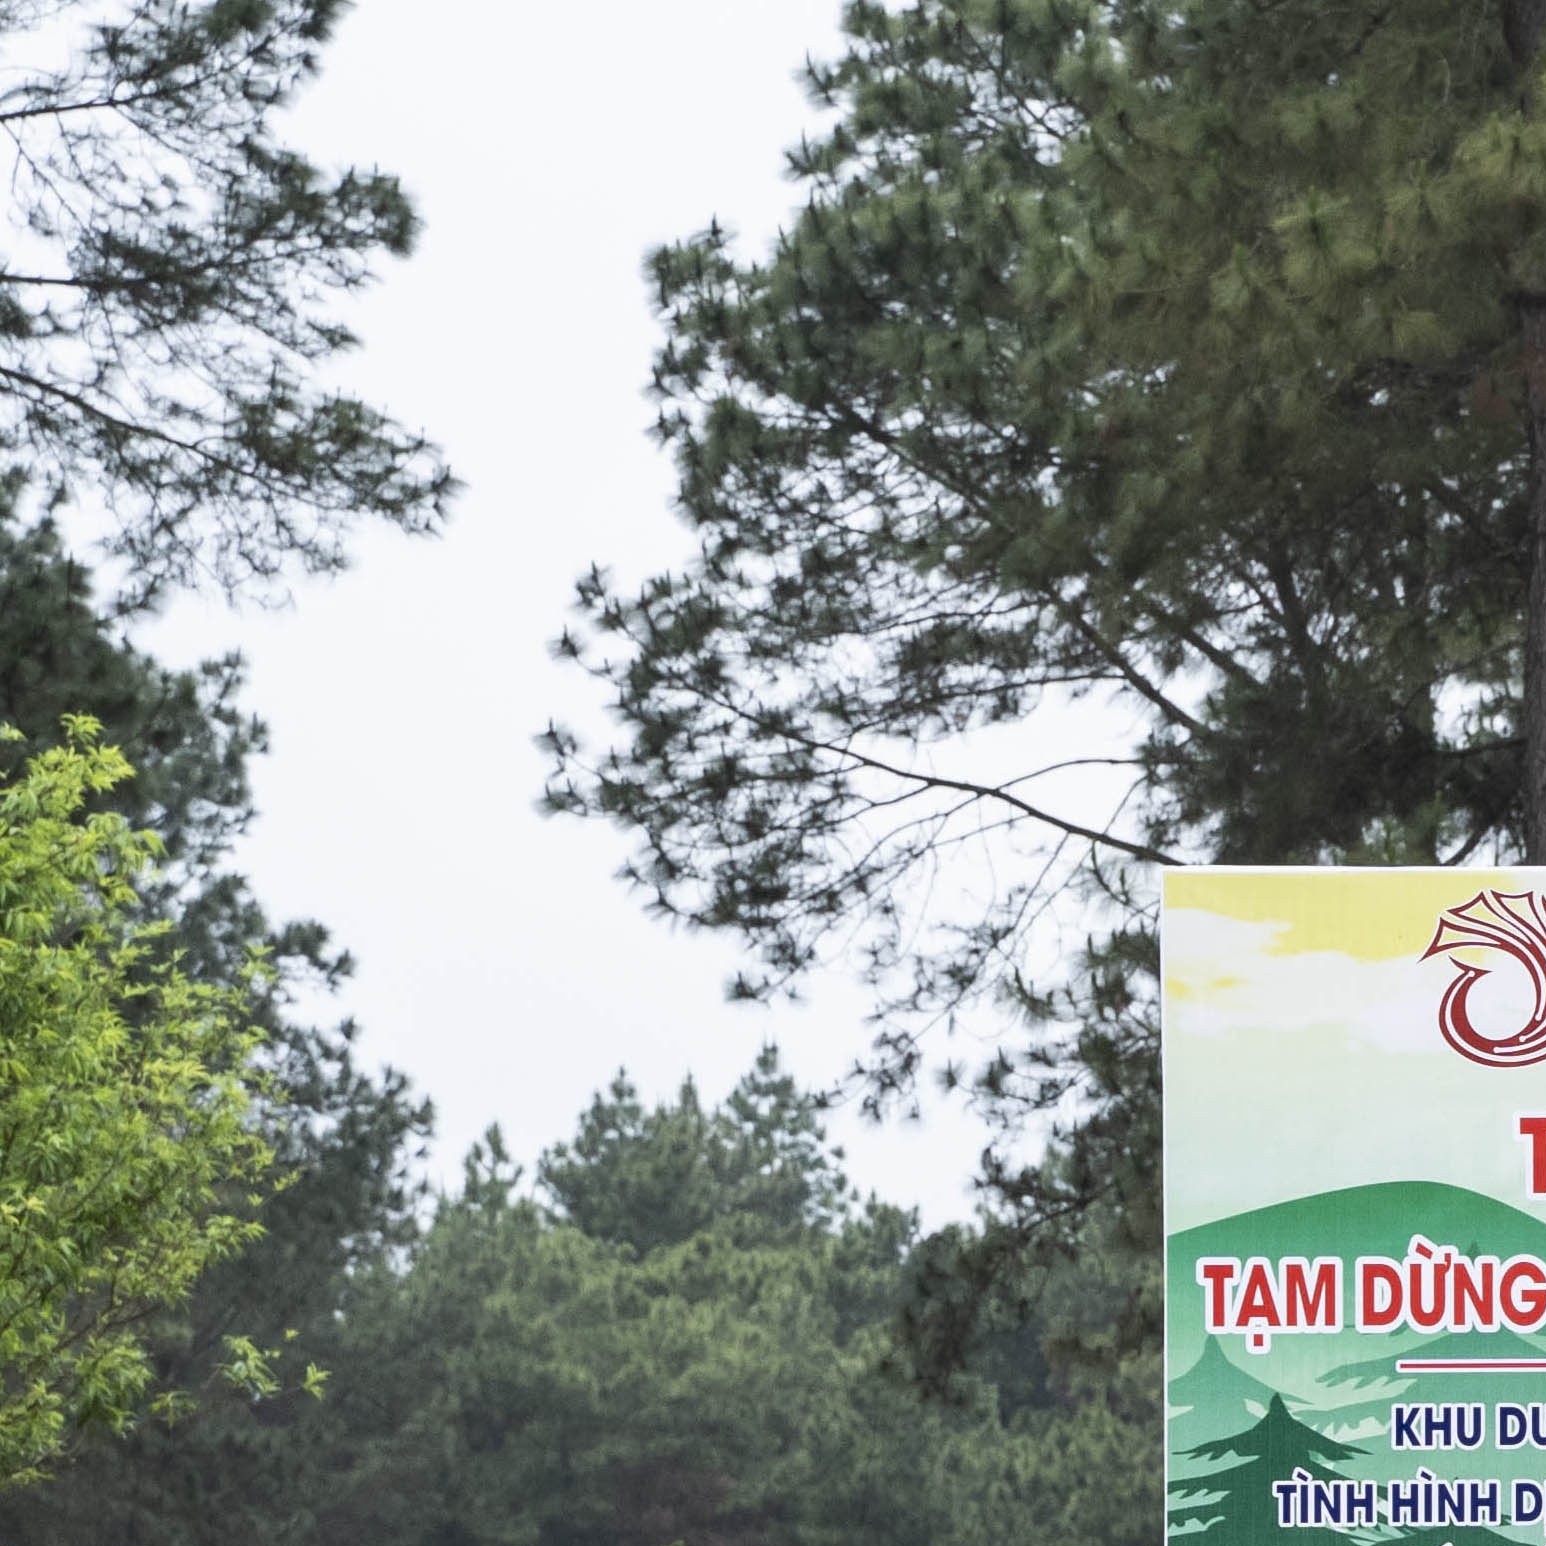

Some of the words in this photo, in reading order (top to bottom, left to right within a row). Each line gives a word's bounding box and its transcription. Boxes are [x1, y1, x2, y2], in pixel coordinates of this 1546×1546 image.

[1202, 1263, 1337, 1348] TẠM
[1394, 1405, 1483, 1448] KHU
[1275, 1470, 1374, 1525] TÌNH
[1391, 1470, 1498, 1524] HÌNH
